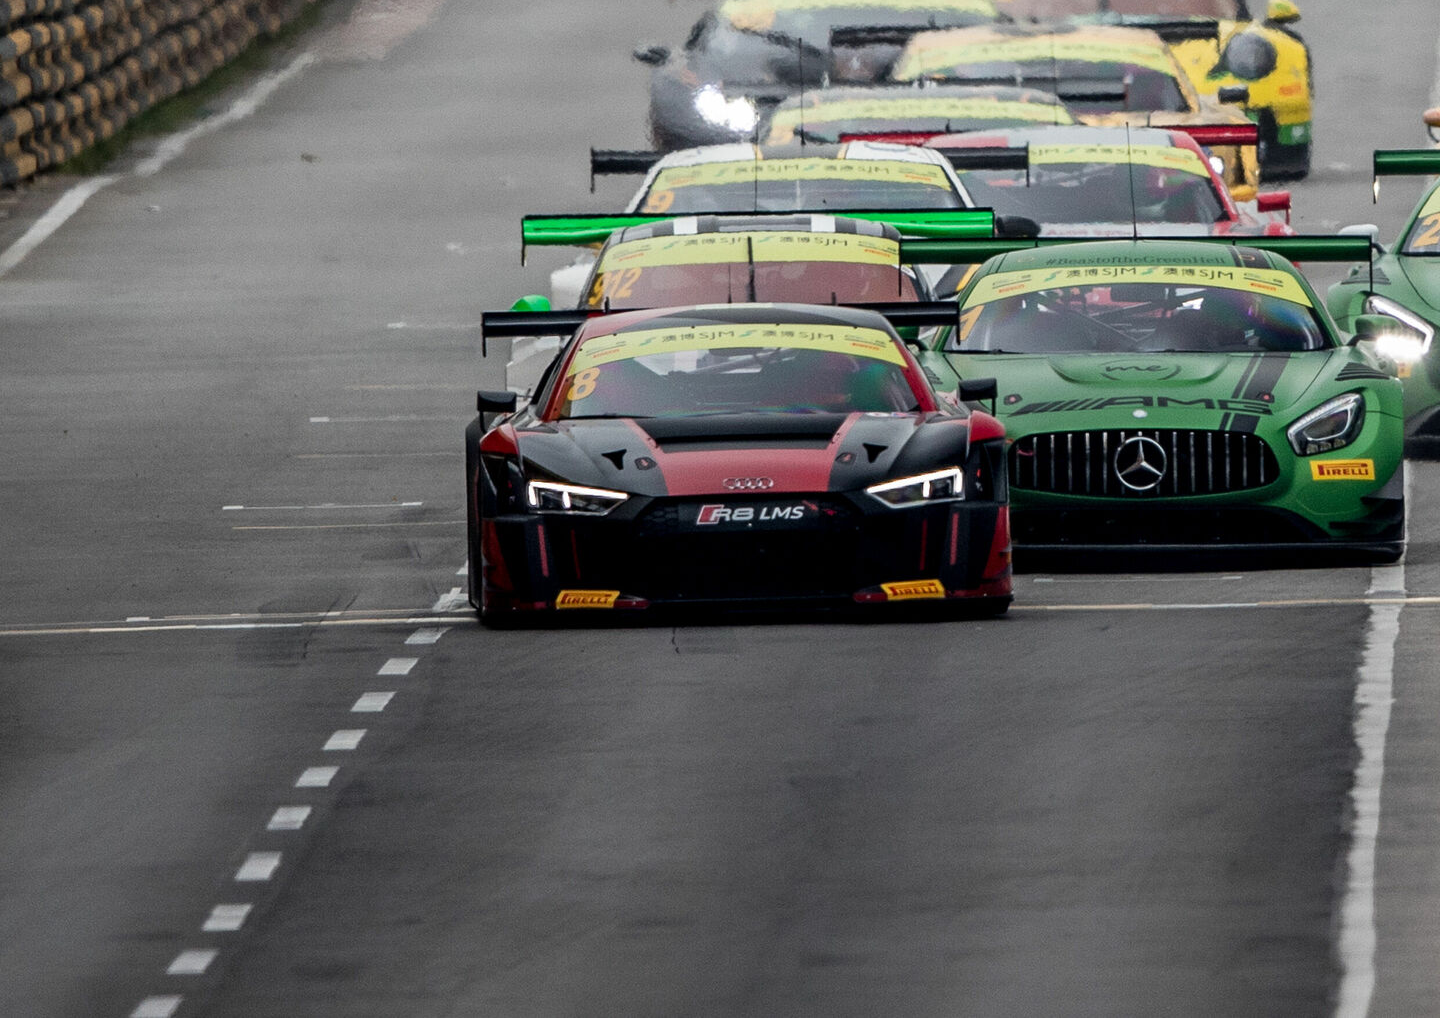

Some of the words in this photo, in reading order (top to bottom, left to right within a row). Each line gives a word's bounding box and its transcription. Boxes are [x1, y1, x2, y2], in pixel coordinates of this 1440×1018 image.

[1102, 267, 1137, 278] SJM
[1199, 268, 1234, 280] SJM
[588, 266, 643, 306] 912
[698, 330, 735, 340] SJM
[799, 331, 835, 341] SJM
[566, 366, 601, 401] 8
[1099, 395, 1273, 416] AMG
[1317, 461, 1370, 478] PIRELLI
[709, 506, 754, 522] R8
[758, 505, 806, 521] LMS
[889, 582, 940, 598] PIRELLI
[560, 593, 612, 606] PIRELLI
